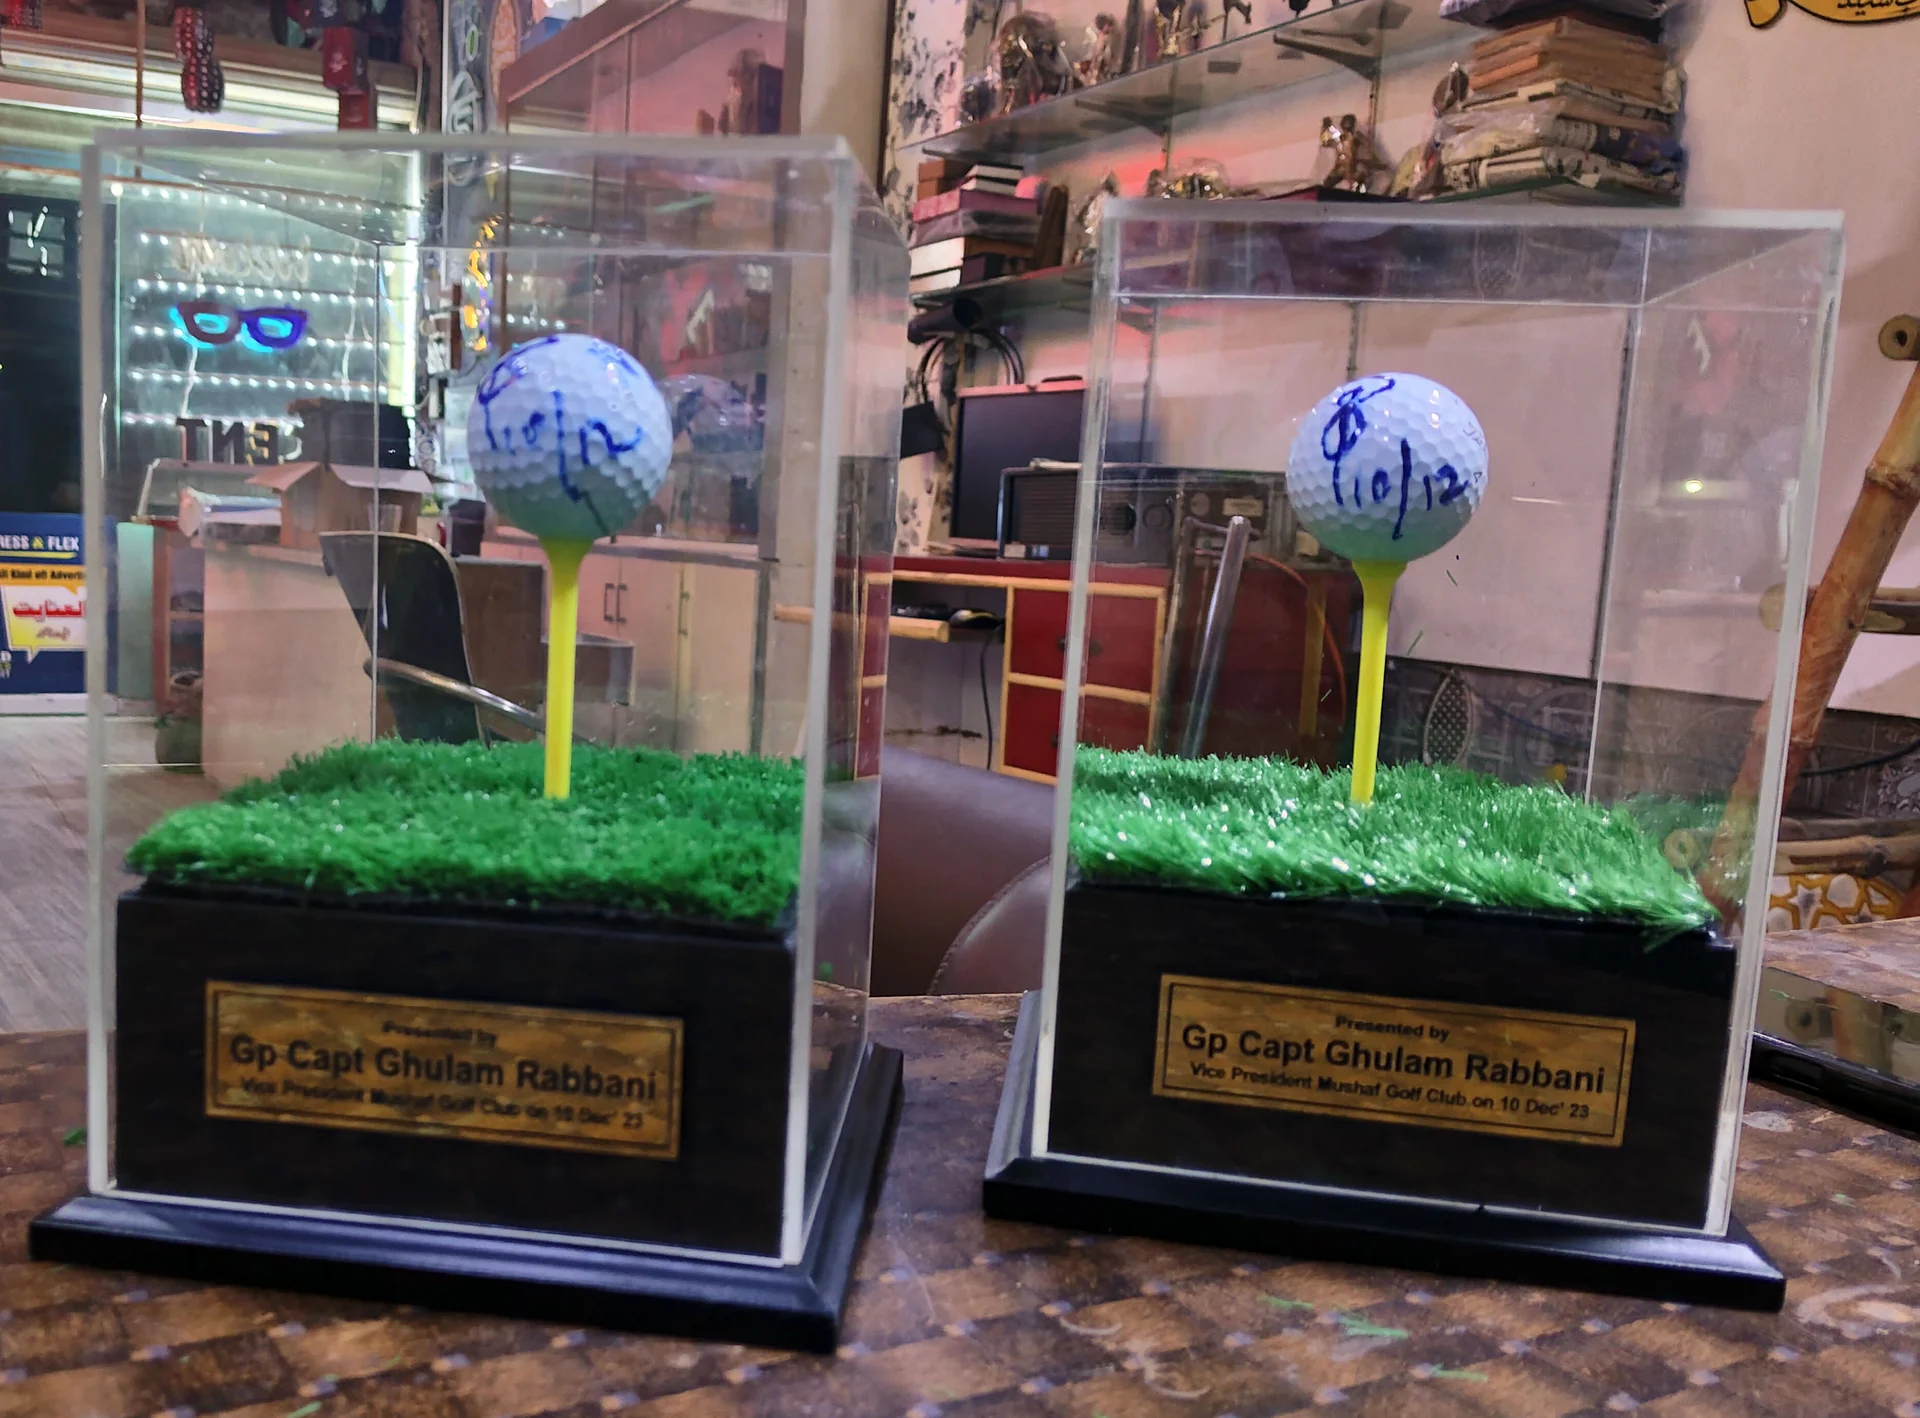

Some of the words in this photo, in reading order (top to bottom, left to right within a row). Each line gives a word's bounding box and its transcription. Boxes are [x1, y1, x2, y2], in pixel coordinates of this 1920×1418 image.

[48, 535, 80, 551] FLEX
[1335, 1015, 1424, 1037] Presented
[1429, 1025, 1450, 1043] by
[230, 1033, 277, 1072] Gp
[288, 1039, 364, 1078] Capt
[374, 1047, 505, 1086] Ghulam
[516, 1059, 657, 1100] Rabbani
[1182, 1023, 1228, 1059] Gp
[1239, 1029, 1315, 1067] Capt
[1325, 1039, 1454, 1078] Ghulam
[1465, 1053, 1605, 1094] Rabbani
[1190, 1061, 1226, 1079] Vice
[1231, 1066, 1313, 1089] President
[1317, 1076, 1381, 1096] Mushaf
[1385, 1083, 1424, 1100] Golf
[1426, 1088, 1468, 1106] Club
[1472, 1097, 1494, 1110] on
[1500, 1096, 1521, 1112] 10
[1525, 1098, 1565, 1116] Dec'
[1569, 1102, 1590, 1119] 23
[623, 1111, 645, 1130] 23
